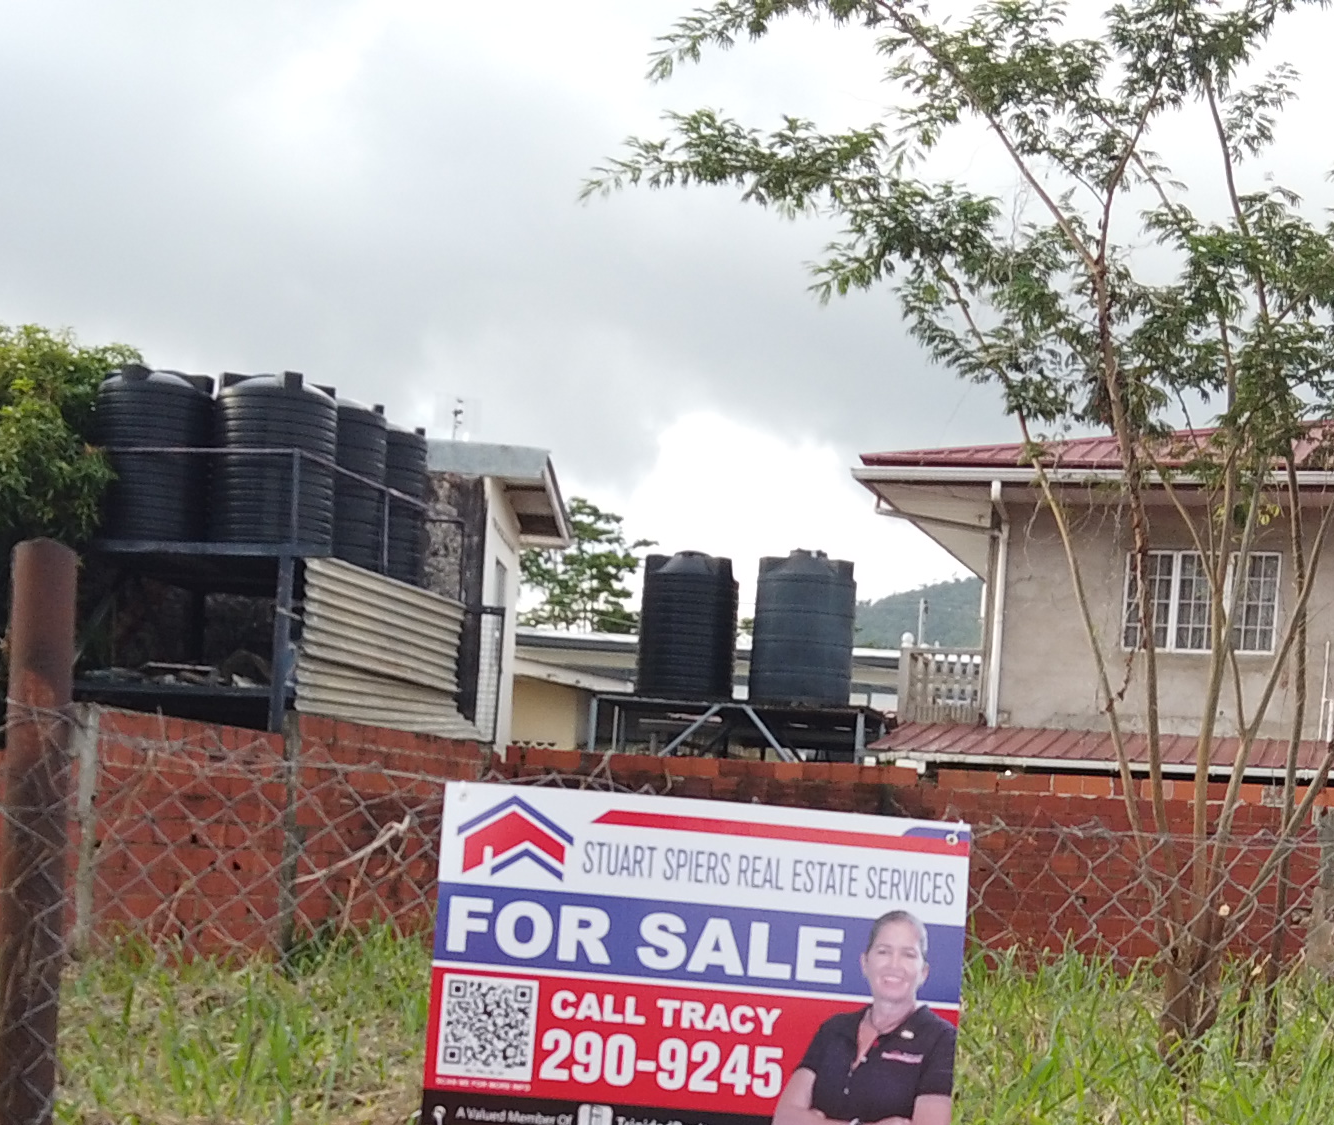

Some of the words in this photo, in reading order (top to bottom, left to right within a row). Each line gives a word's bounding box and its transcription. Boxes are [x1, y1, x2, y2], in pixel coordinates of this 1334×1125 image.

[583, 841, 657, 878] STUART
[664, 847, 731, 886] SPIERS
[737, 855, 783, 891] REAL
[792, 859, 859, 898] ESTATE
[866, 866, 955, 906] SERVICES
[446, 895, 611, 965] FOR
[636, 912, 845, 984] SALE
[551, 990, 646, 1025] CALL
[656, 998, 782, 1035] TRACY
[539, 1028, 784, 1098] 290-9245
[455, 1106, 466, 1119] A
[468, 1107, 507, 1123] Valued
[507, 1110, 556, 1125] Member
